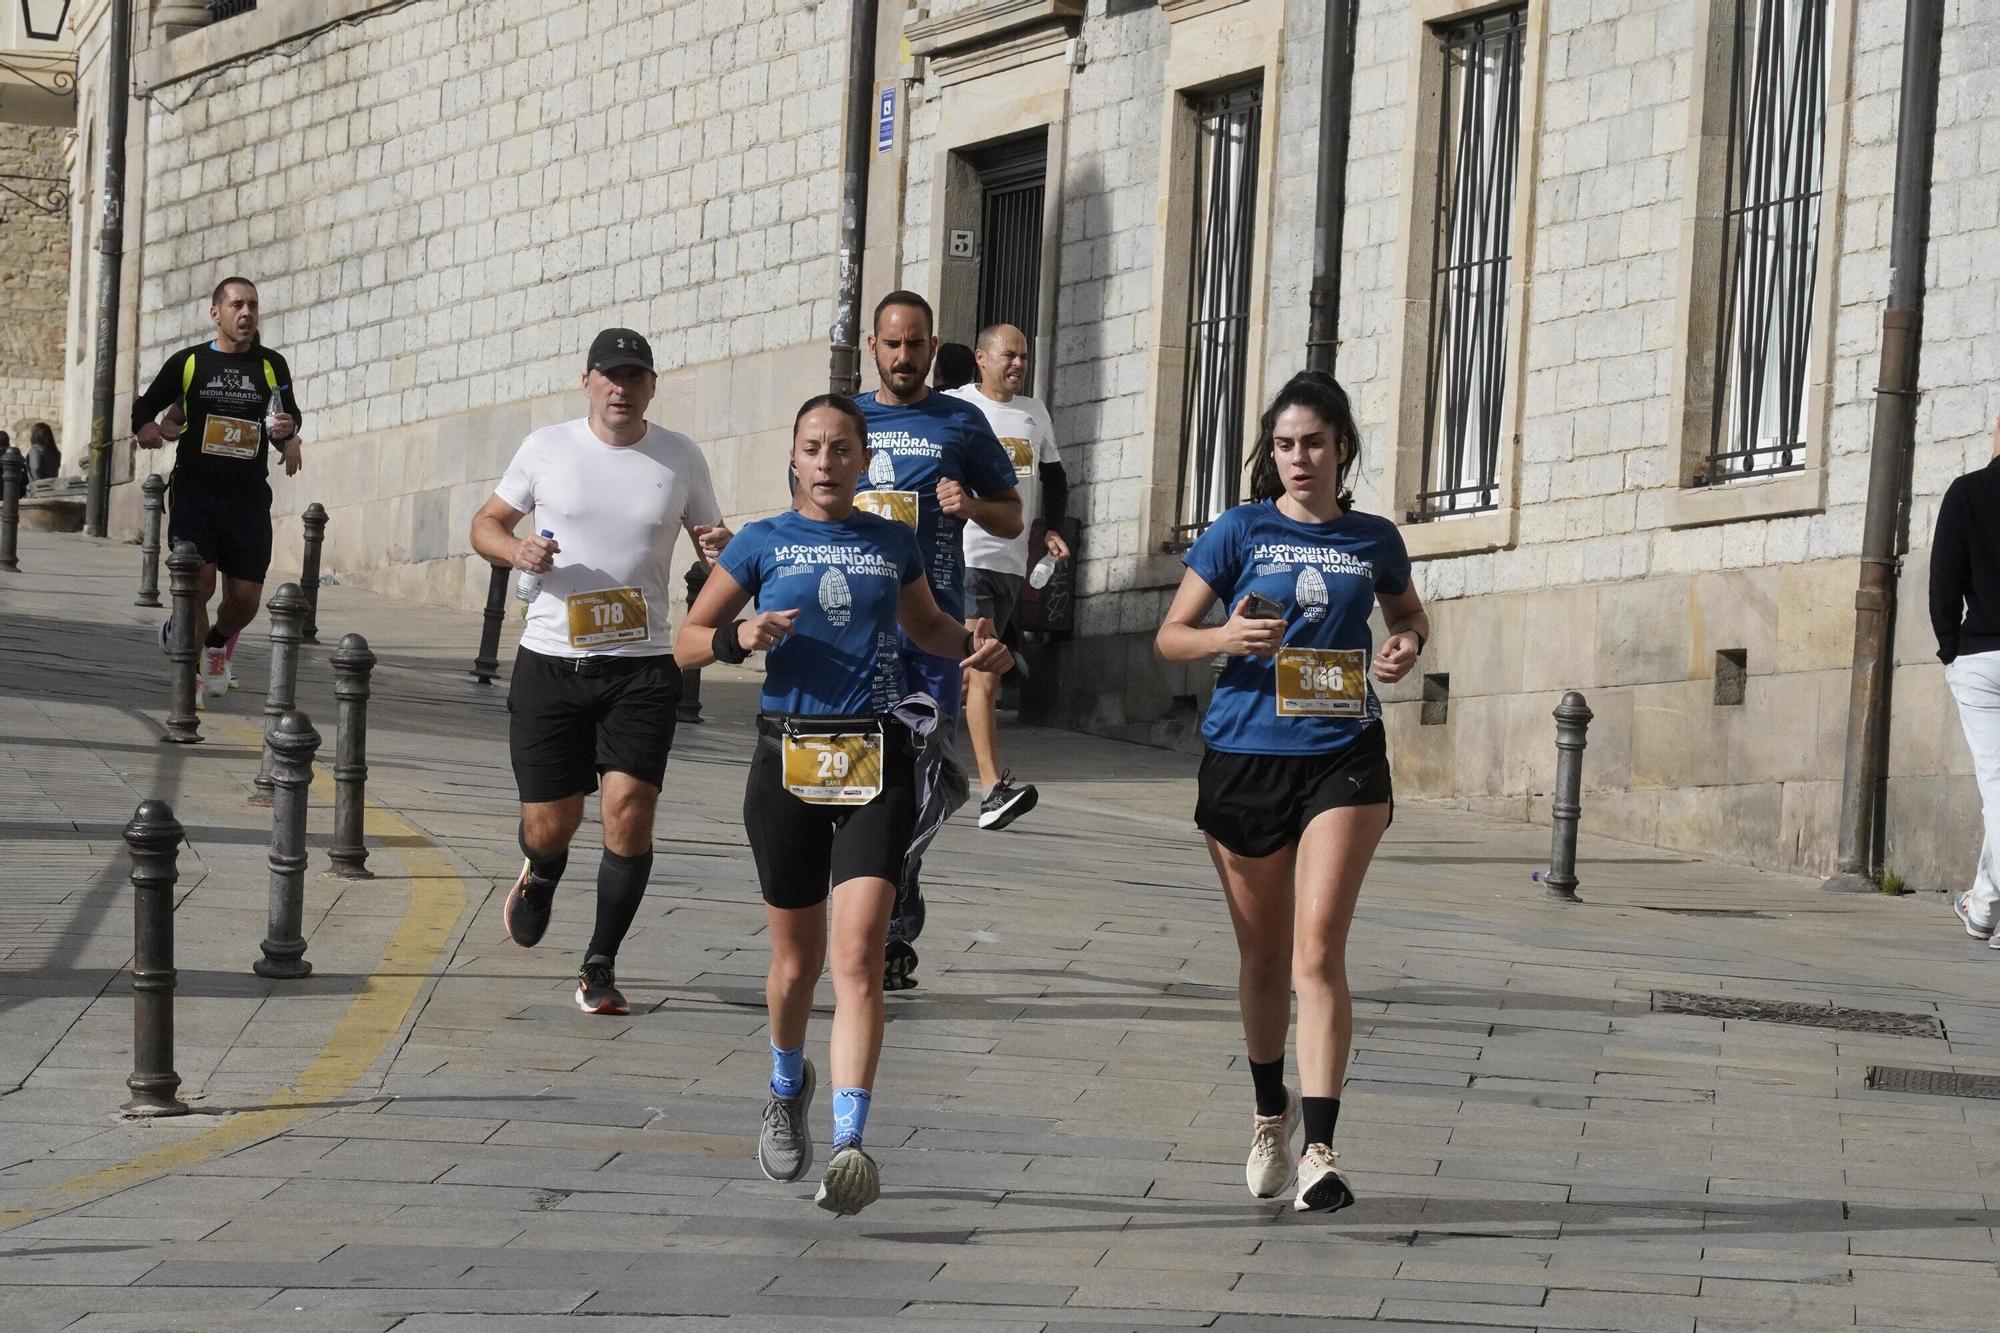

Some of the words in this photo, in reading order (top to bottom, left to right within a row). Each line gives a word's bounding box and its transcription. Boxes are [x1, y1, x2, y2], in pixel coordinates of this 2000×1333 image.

[200, 389, 224, 397] MEDIA
[224, 390, 262, 400] MARATÓN
[224, 427, 241, 442] 24
[867, 431, 909, 440] NQUISTA
[867, 438, 929, 449] MENDRA
[893, 448, 942, 459] KONKISTA
[775, 546, 789, 556] LA
[790, 545, 861, 554] CONQUISTA
[1254, 544, 1268, 554] LA
[1268, 544, 1338, 554] CONQUISTA
[794, 553, 886, 565] ALMENDRA
[1273, 553, 1360, 566] ALMENDRA
[847, 565, 898, 579] KONKISTA
[1323, 564, 1373, 579] KONKISTA
[591, 602, 624, 626] 178
[1299, 665, 1344, 692] 366
[817, 751, 849, 778] 29
